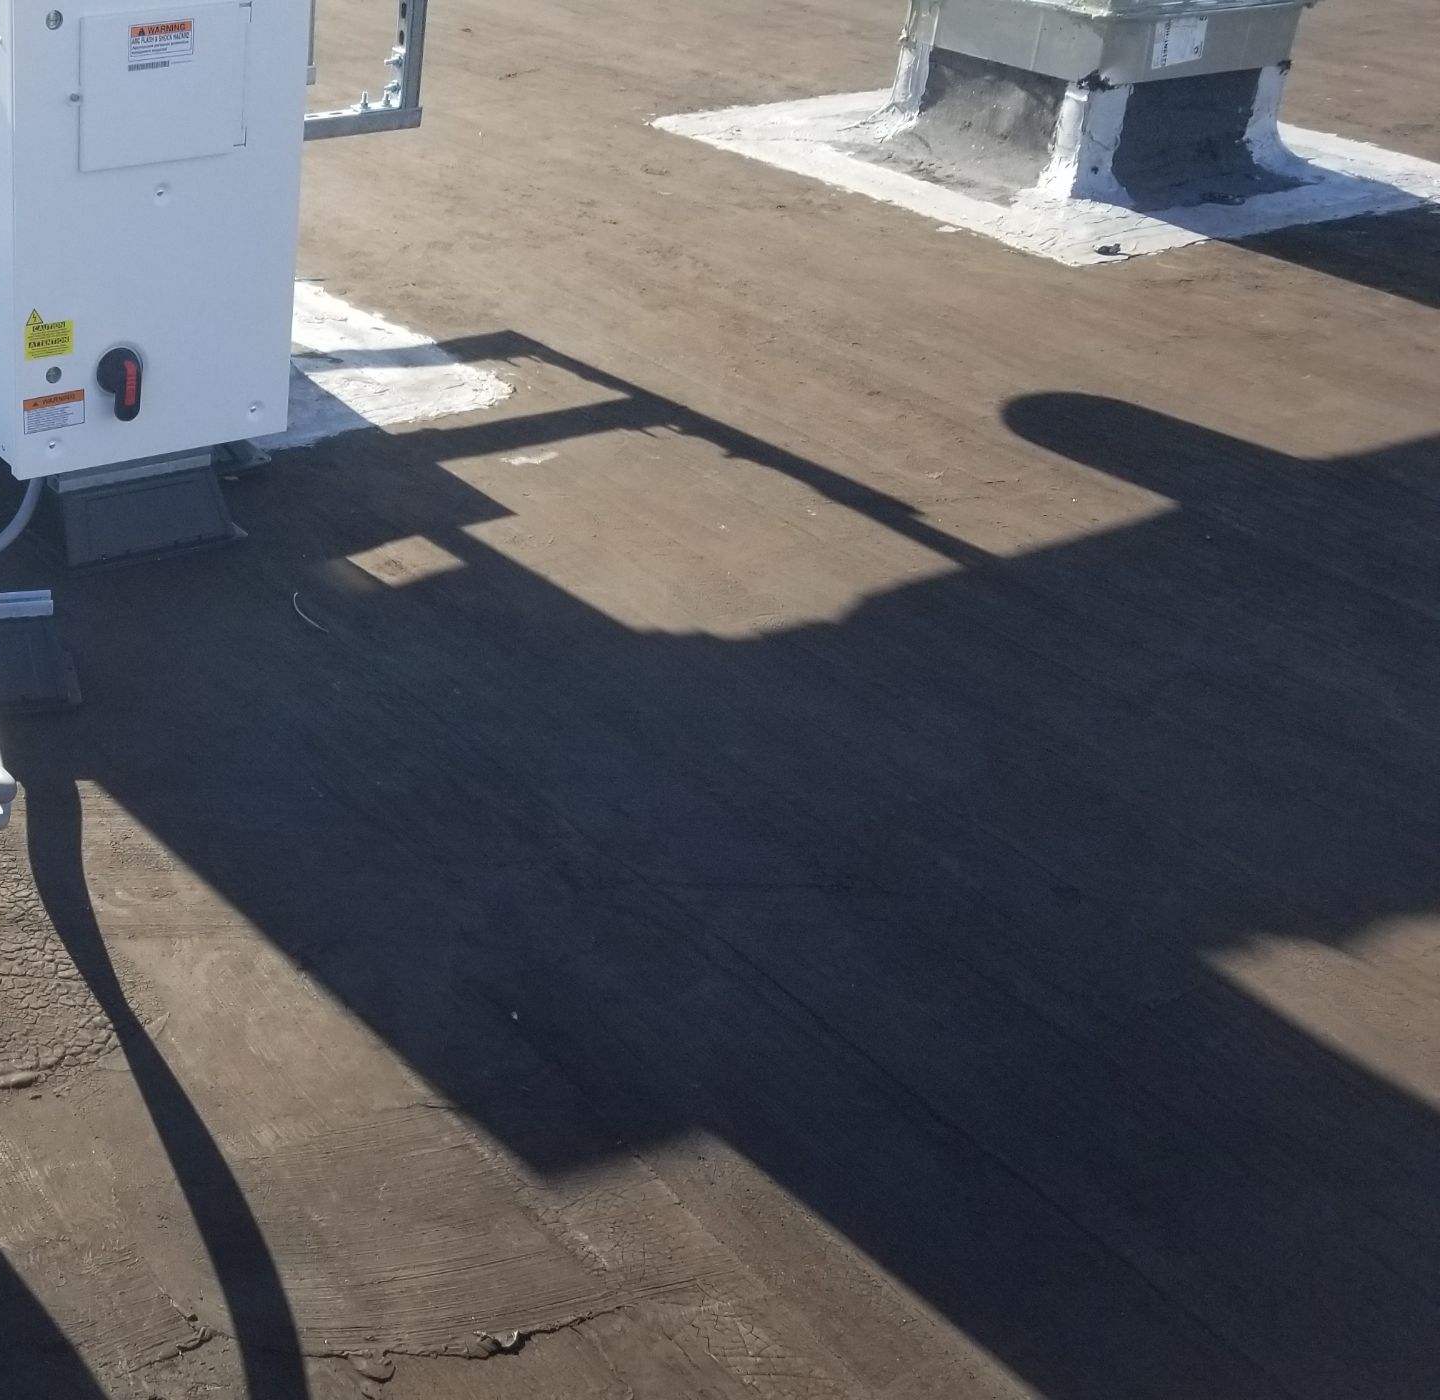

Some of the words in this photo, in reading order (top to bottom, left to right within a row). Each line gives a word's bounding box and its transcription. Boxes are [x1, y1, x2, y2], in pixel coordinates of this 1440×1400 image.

[147, 23, 186, 34] WARNING
[32, 321, 65, 332] CAUTION
[28, 336, 69, 348] ATTENTION
[42, 393, 75, 404] WARNING
